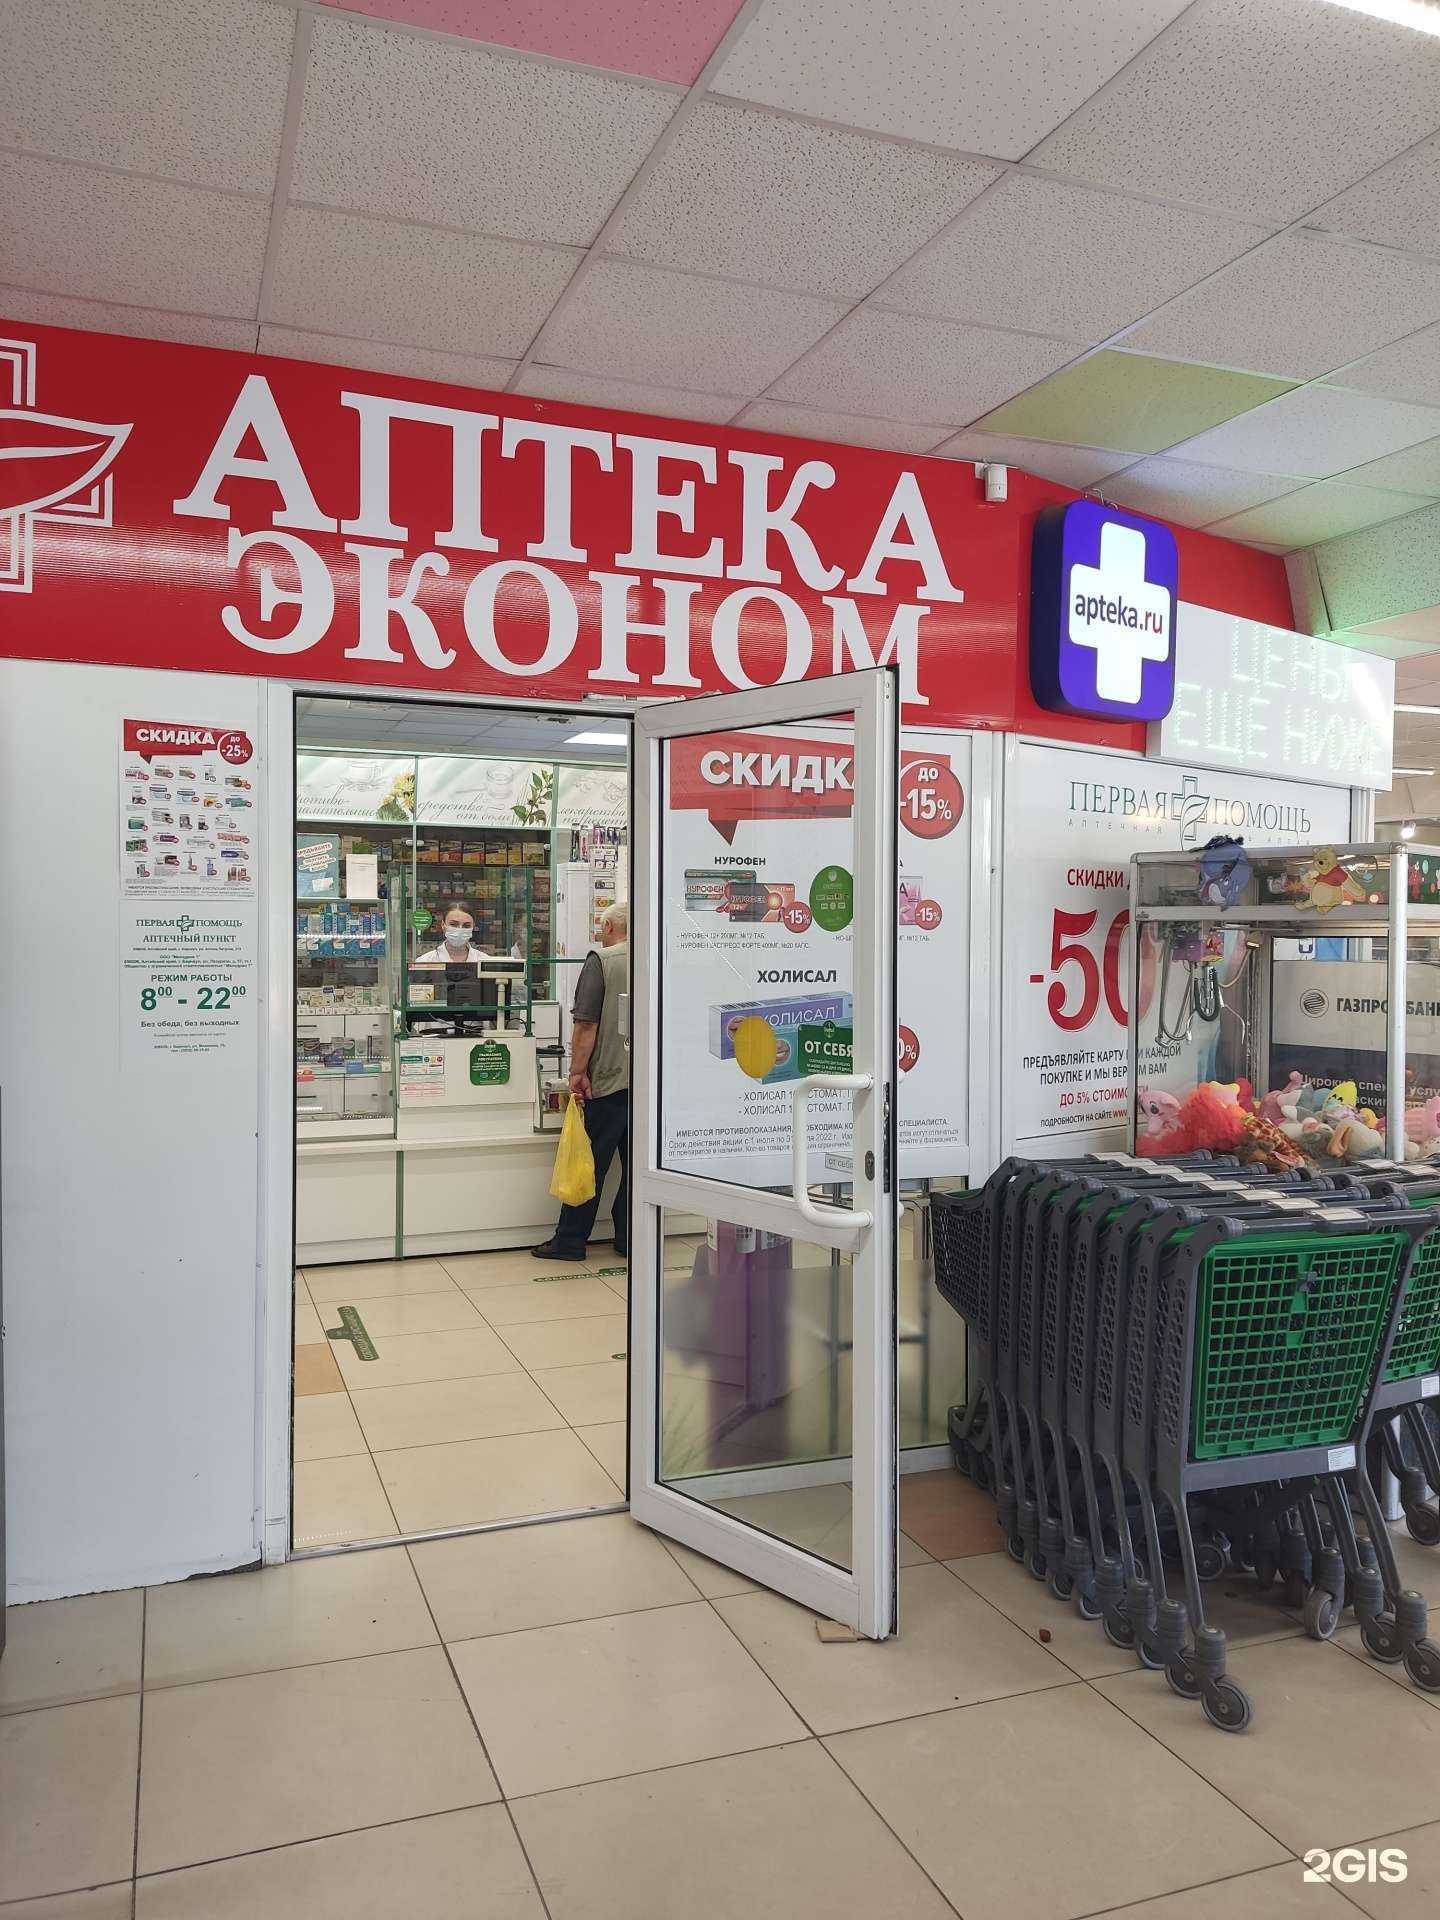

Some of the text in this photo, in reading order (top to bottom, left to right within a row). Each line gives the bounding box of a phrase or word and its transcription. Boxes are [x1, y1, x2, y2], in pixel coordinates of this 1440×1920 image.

[173, 374, 964, 603] АПТЕКА
[221, 526, 932, 707] ЭКОНОМ
[1075, 590, 1164, 636] apteka.ru
[1232, 619, 1350, 704] ЦЕНЫ
[136, 728, 215, 745] СКИДКА
[221, 745, 249, 758] -25%
[700, 750, 854, 794] СКИДК
[917, 767, 939, 782] ДО
[898, 788, 952, 820] -15%
[1069, 780, 1312, 836] ПЕРВАЯ ПОМОЩЬ
[1068, 819, 1163, 834] АПТЕЧНАЯ
[714, 856, 766, 866] НУРОФЕН
[1067, 868, 1124, 890] СКИДКИ
[687, 885, 724, 893] НУРОФЕН
[785, 909, 811, 924] -15%
[916, 907, 940, 923] -15%
[136, 919, 243, 928] ПЕРВАЯ ПОМОЩЬ
[143, 933, 237, 943] АПТЕЧНЫЙ ПУНКТ
[151, 974, 232, 982] РЕЖИМ РАБОТЫ
[757, 969, 837, 984] ХОЛИСАЛ
[804, 1040, 820, 1054] ОТ
[1023, 1050, 1095, 1070] ПРЕДЪЯВЛЯЙТЕ
[1097, 1048, 1123, 1062] КАРТУ
[1145, 1043, 1181, 1059] КАЖДОЙ
[1040, 1068, 1083, 1086] ПОКУПКЕ
[1085, 1069, 1092, 1081] И
[1094, 1068, 1110, 1081] МЫ
[1149, 1062, 1167, 1075] ВАМ
[743, 1089, 786, 1102] ХОЛИСАЛ
[1059, 1094, 1074, 1109] ДО
[1077, 1091, 1090, 1104] 5%
[743, 1104, 786, 1116] ХОЛИСАЛ
[1040, 1113, 1084, 1128] ПОДРОБНОСТИ
[1085, 1112, 1093, 1123] НА
[1093, 1110, 1112, 1122] САЙТЕ
[668, 1140, 687, 1149] Срок
[688, 1139, 721, 1149] действия
[722, 1138, 743, 1147] акции
[816, 1133, 832, 1141] 2022
[676, 1128, 714, 1138] ИМЕЮТСЯ
